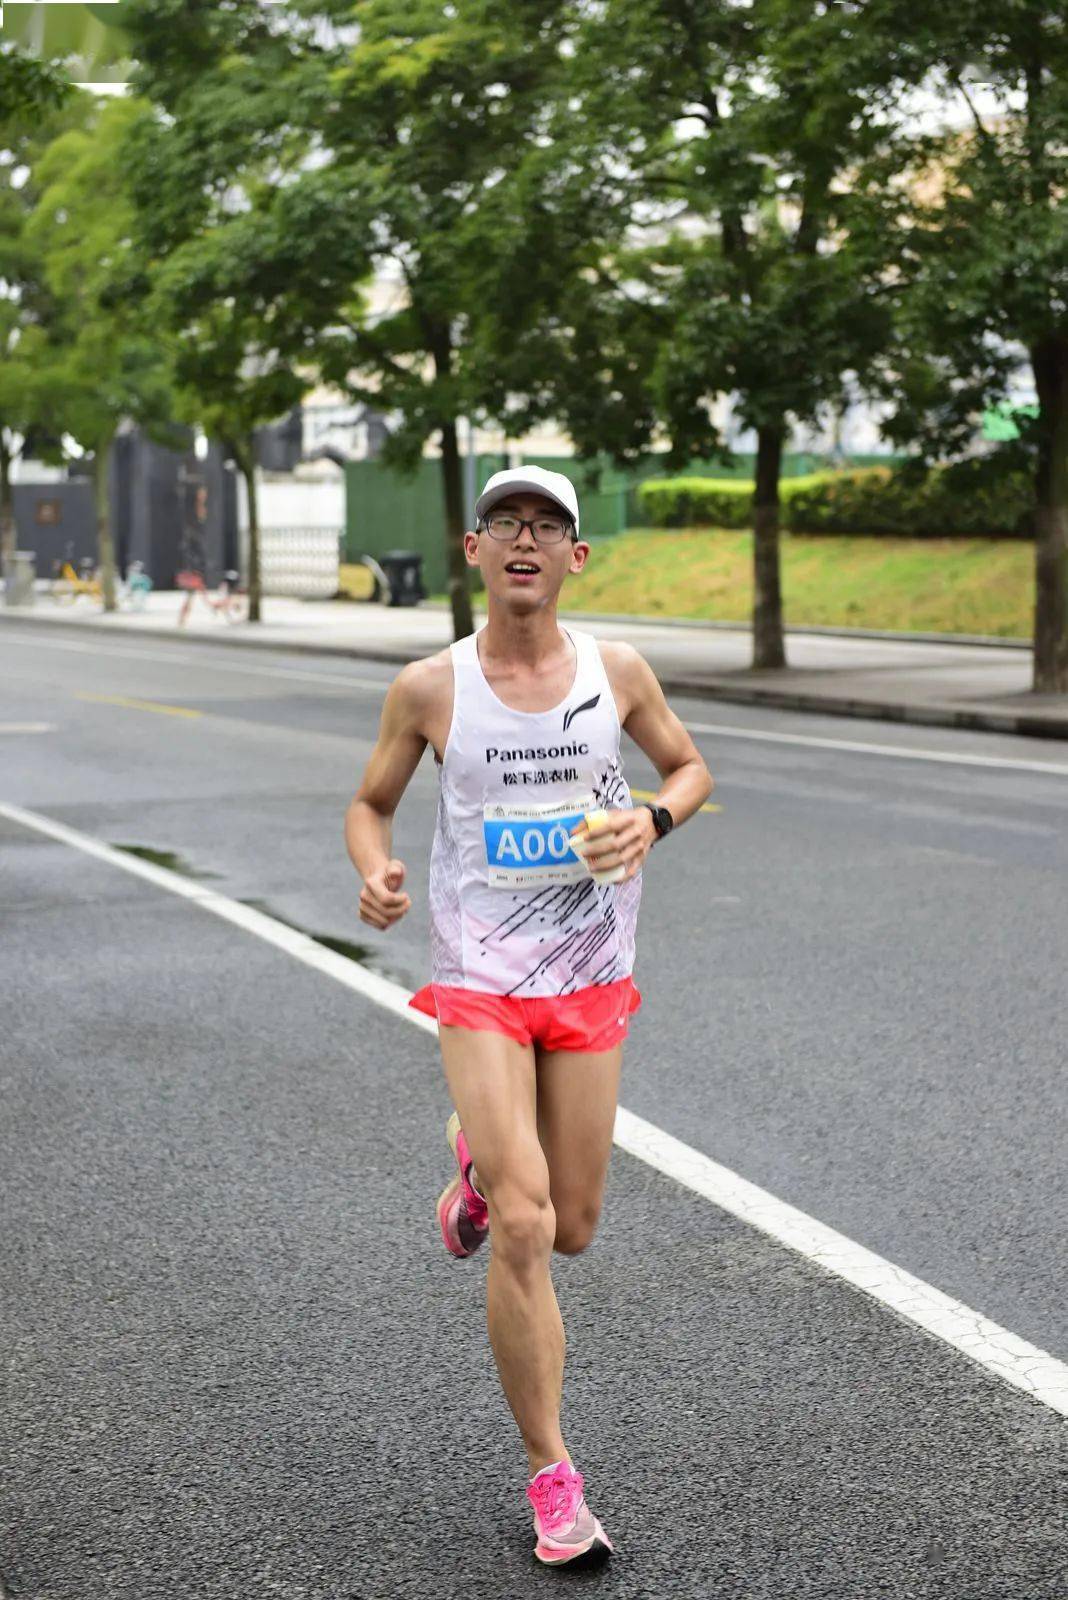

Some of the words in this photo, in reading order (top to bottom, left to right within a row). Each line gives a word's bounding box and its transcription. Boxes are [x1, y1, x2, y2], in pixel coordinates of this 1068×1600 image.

[486, 740, 589, 763] Panasonic
[503, 767, 579, 786] 松下洗衣机
